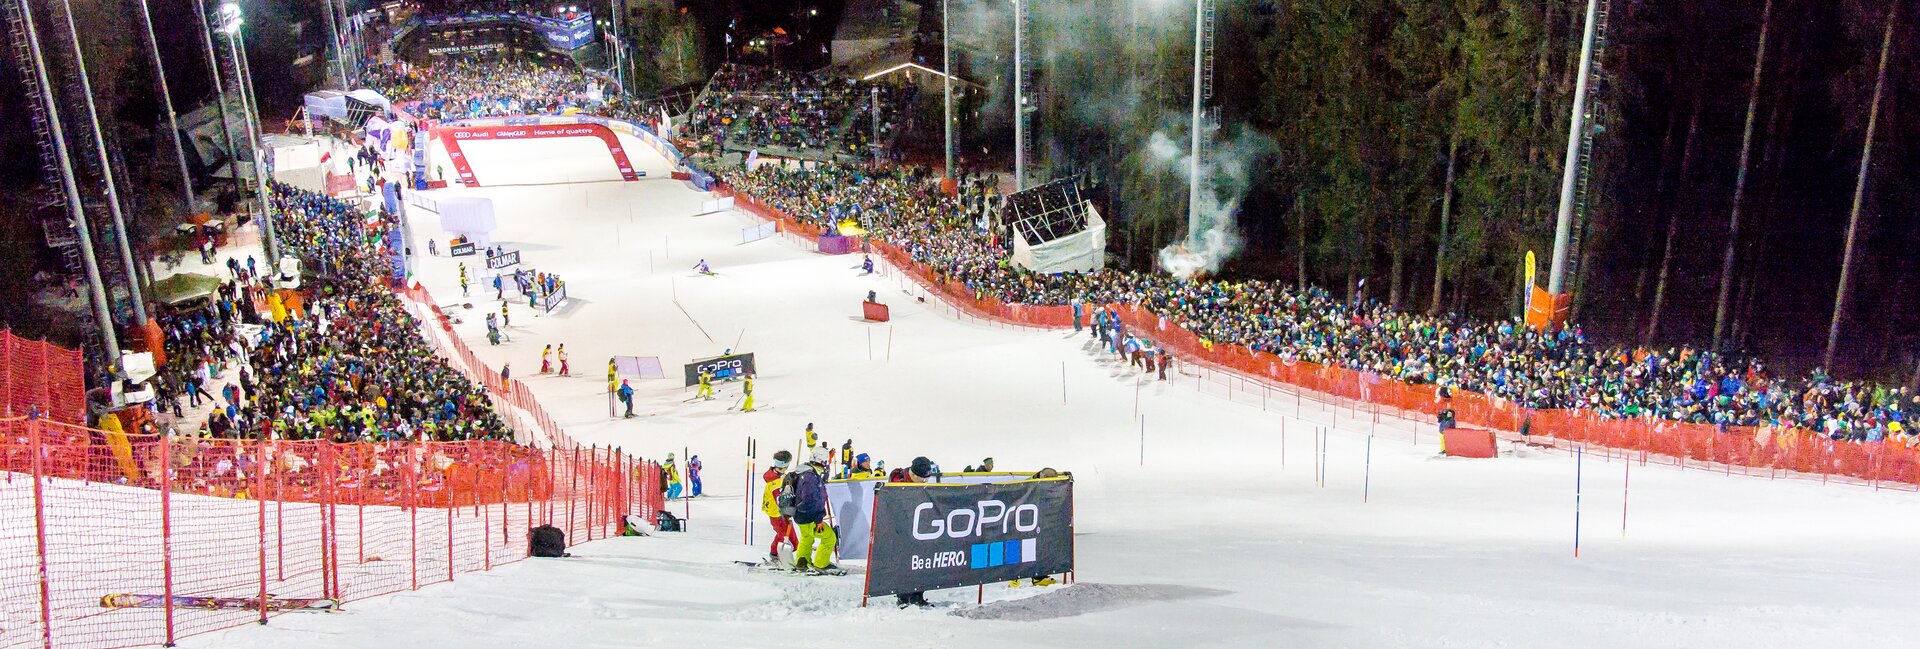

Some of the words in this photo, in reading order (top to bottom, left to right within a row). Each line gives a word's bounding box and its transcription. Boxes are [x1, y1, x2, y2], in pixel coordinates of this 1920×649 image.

[429, 46, 461, 54] MADONNA
[453, 246, 474, 255] COLMAR
[490, 252, 517, 269] COLMAR
[912, 499, 1039, 540] GoPro
[911, 555, 925, 570] Be
[925, 557, 932, 569] a
[932, 550, 968, 568] HERO.
